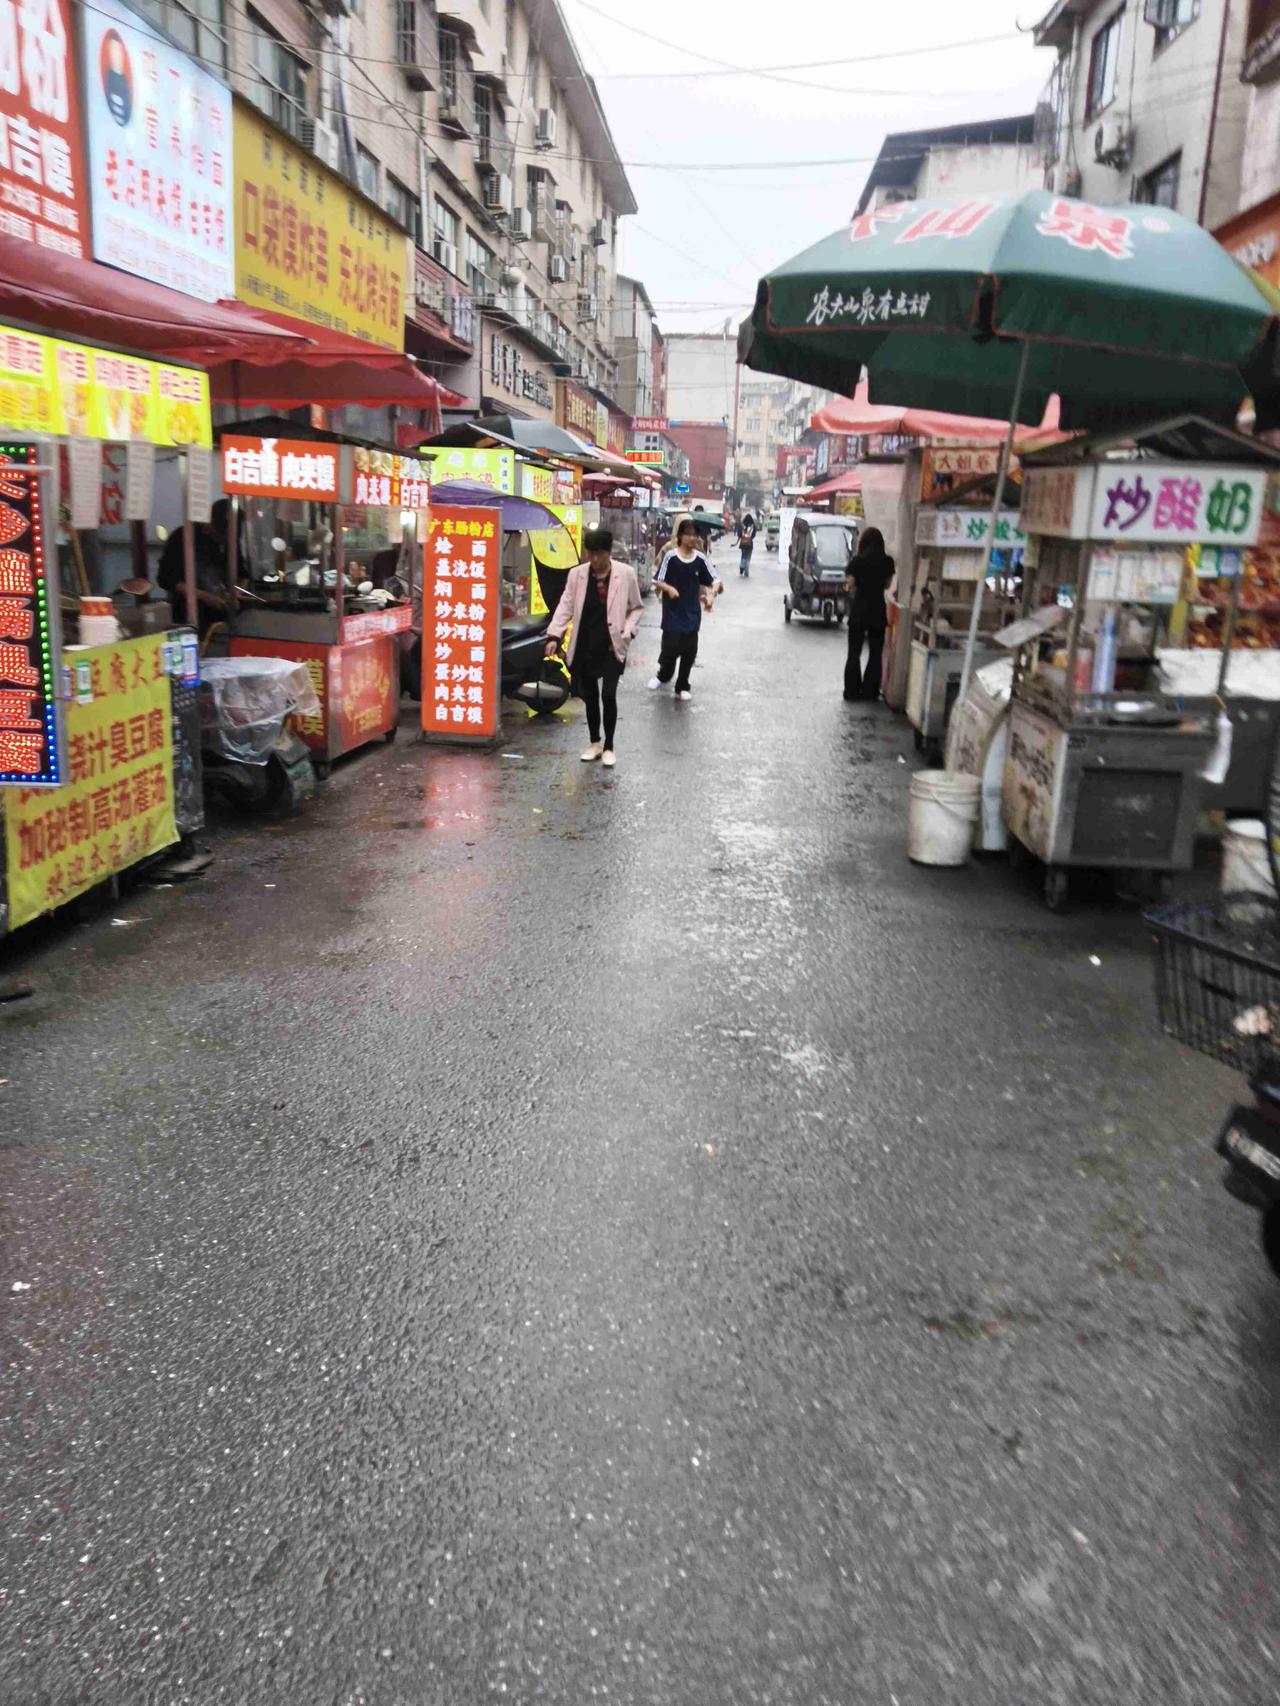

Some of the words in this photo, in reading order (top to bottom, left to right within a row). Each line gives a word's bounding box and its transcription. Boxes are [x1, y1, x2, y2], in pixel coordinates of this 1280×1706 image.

[224, 447, 279, 487] 白吉馍
[281, 452, 335, 491] 肉夹馍
[355, 473, 392, 506] 肉夹馍
[1103, 474, 1253, 533] 炒酸奶
[428, 518, 494, 538] 广东肠粉店
[435, 557, 486, 579] 盖浇饭
[434, 600, 486, 621] 炒米粉
[434, 621, 486, 642] 炒河粉
[434, 642, 486, 663] 炒面
[434, 663, 485, 683] 蛋炒饭
[434, 683, 483, 704] 肉夹馍
[434, 703, 483, 724] 白吉馍
